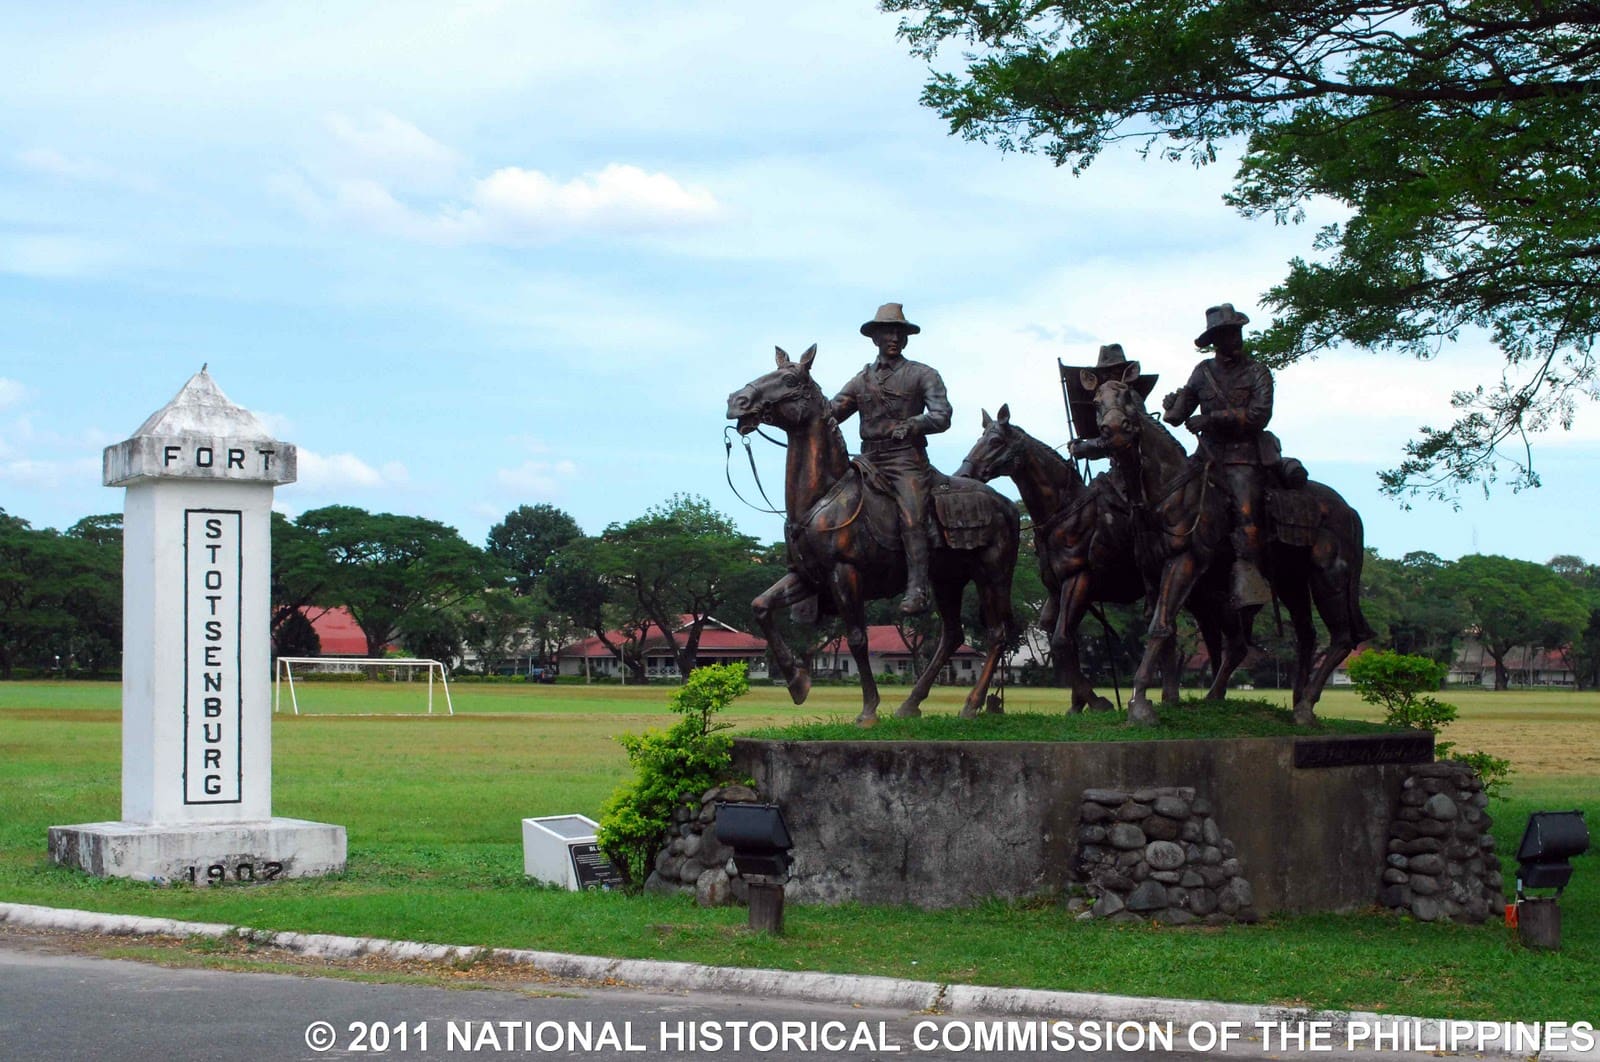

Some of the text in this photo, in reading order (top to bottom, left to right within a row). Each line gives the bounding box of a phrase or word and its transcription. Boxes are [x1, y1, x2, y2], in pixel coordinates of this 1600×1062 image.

[164, 445, 276, 471] FORT
[204, 518, 223, 796] STOTSENBURG
[188, 861, 283, 887] 1902
